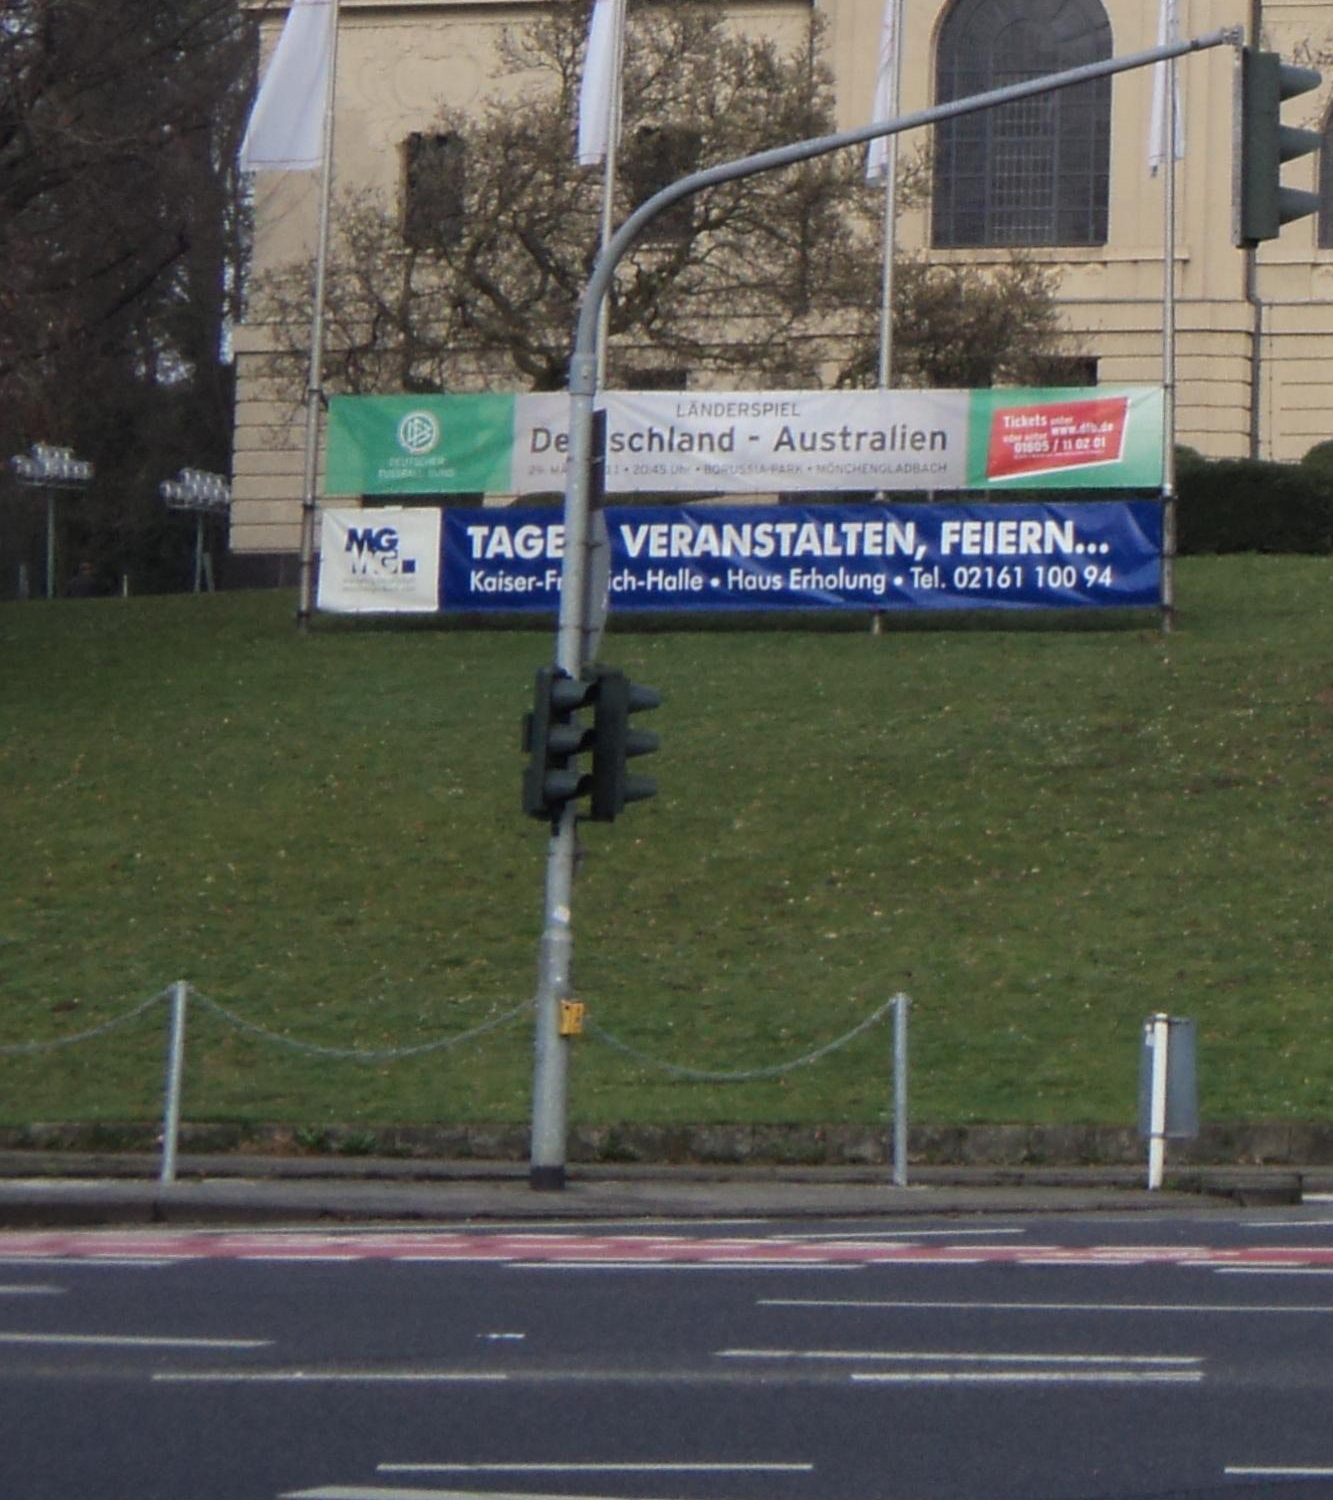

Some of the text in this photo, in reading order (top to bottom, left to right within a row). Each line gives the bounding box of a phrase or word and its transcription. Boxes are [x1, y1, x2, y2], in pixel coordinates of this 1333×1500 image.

[676, 402, 800, 418] LÄNDERSPIEL
[1003, 414, 1047, 428] Tickets
[530, 426, 735, 453] Deschland
[773, 425, 947, 452] Australien
[816, 461, 947, 476] MÖNCHENGLADBACH
[467, 521, 1110, 561] TAGE VERANSTALTEN, FEIERN...
[470, 564, 1113, 595] Kaiser-Frich-Halle Haus Erholung Tel. 02161 100 94
